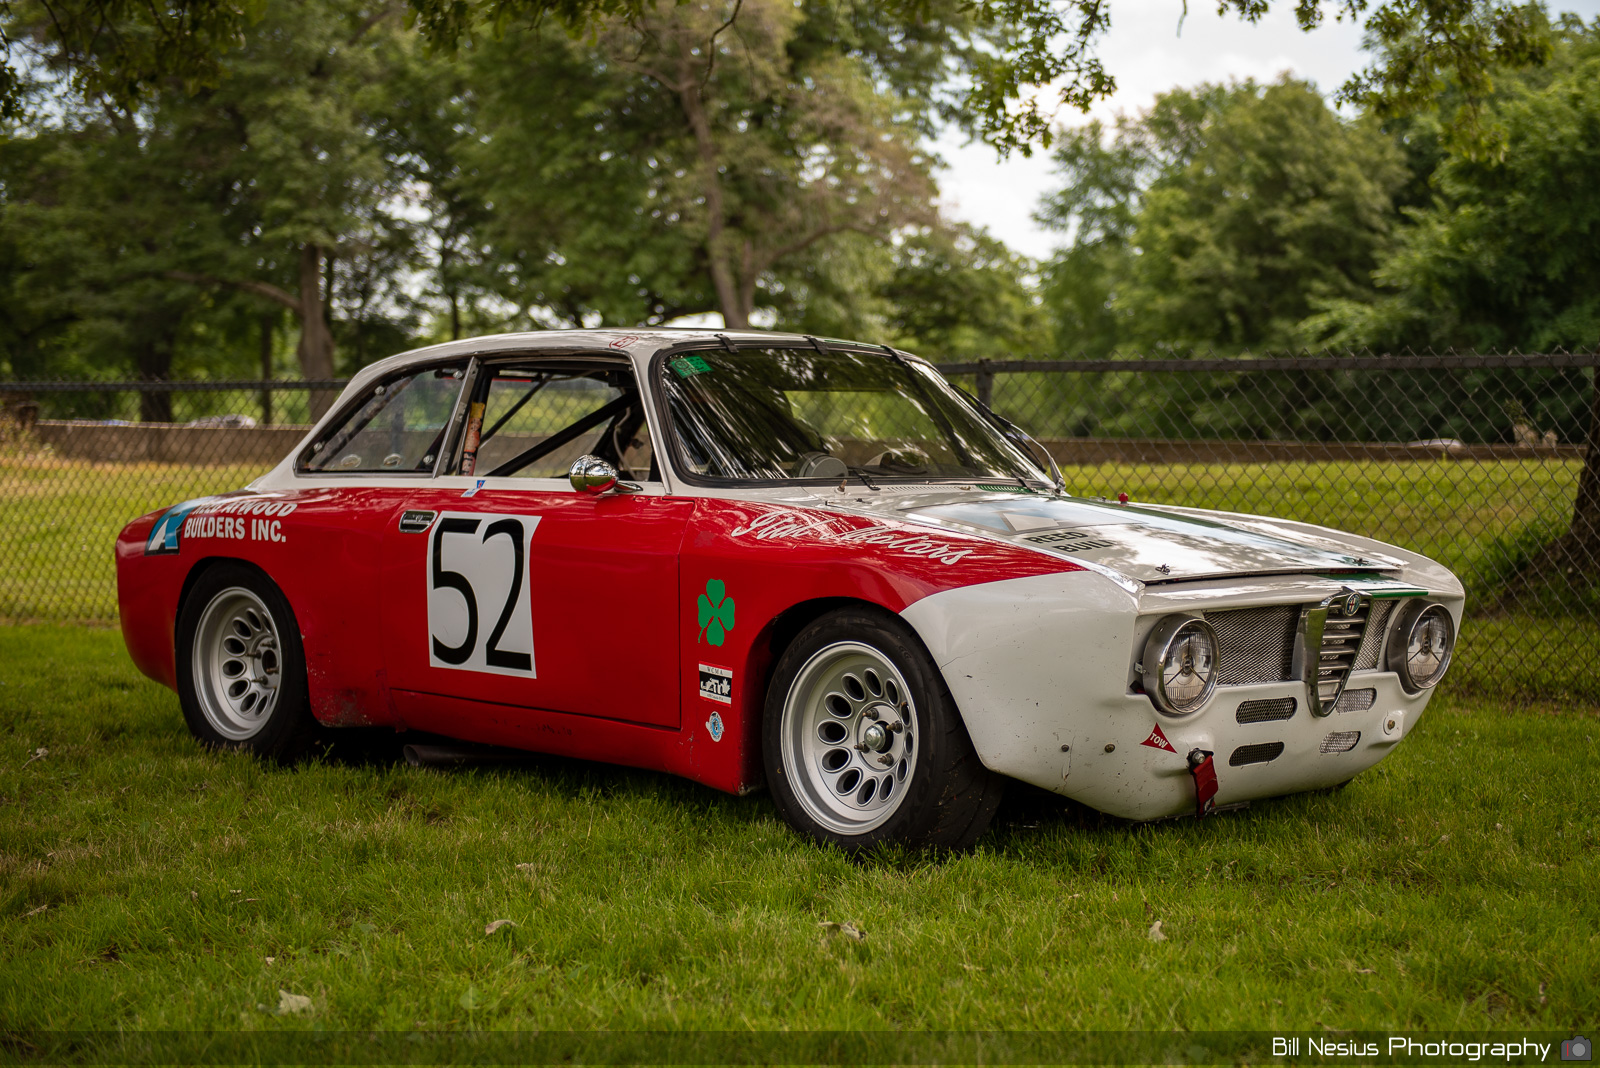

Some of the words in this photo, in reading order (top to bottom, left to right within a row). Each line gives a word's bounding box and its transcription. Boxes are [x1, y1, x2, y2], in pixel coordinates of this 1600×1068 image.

[184, 517, 245, 539] BUILDERS
[251, 519, 286, 542] INC.
[1023, 531, 1089, 544] REED
[432, 518, 532, 671] 52
[1150, 733, 1168, 748] TOW
